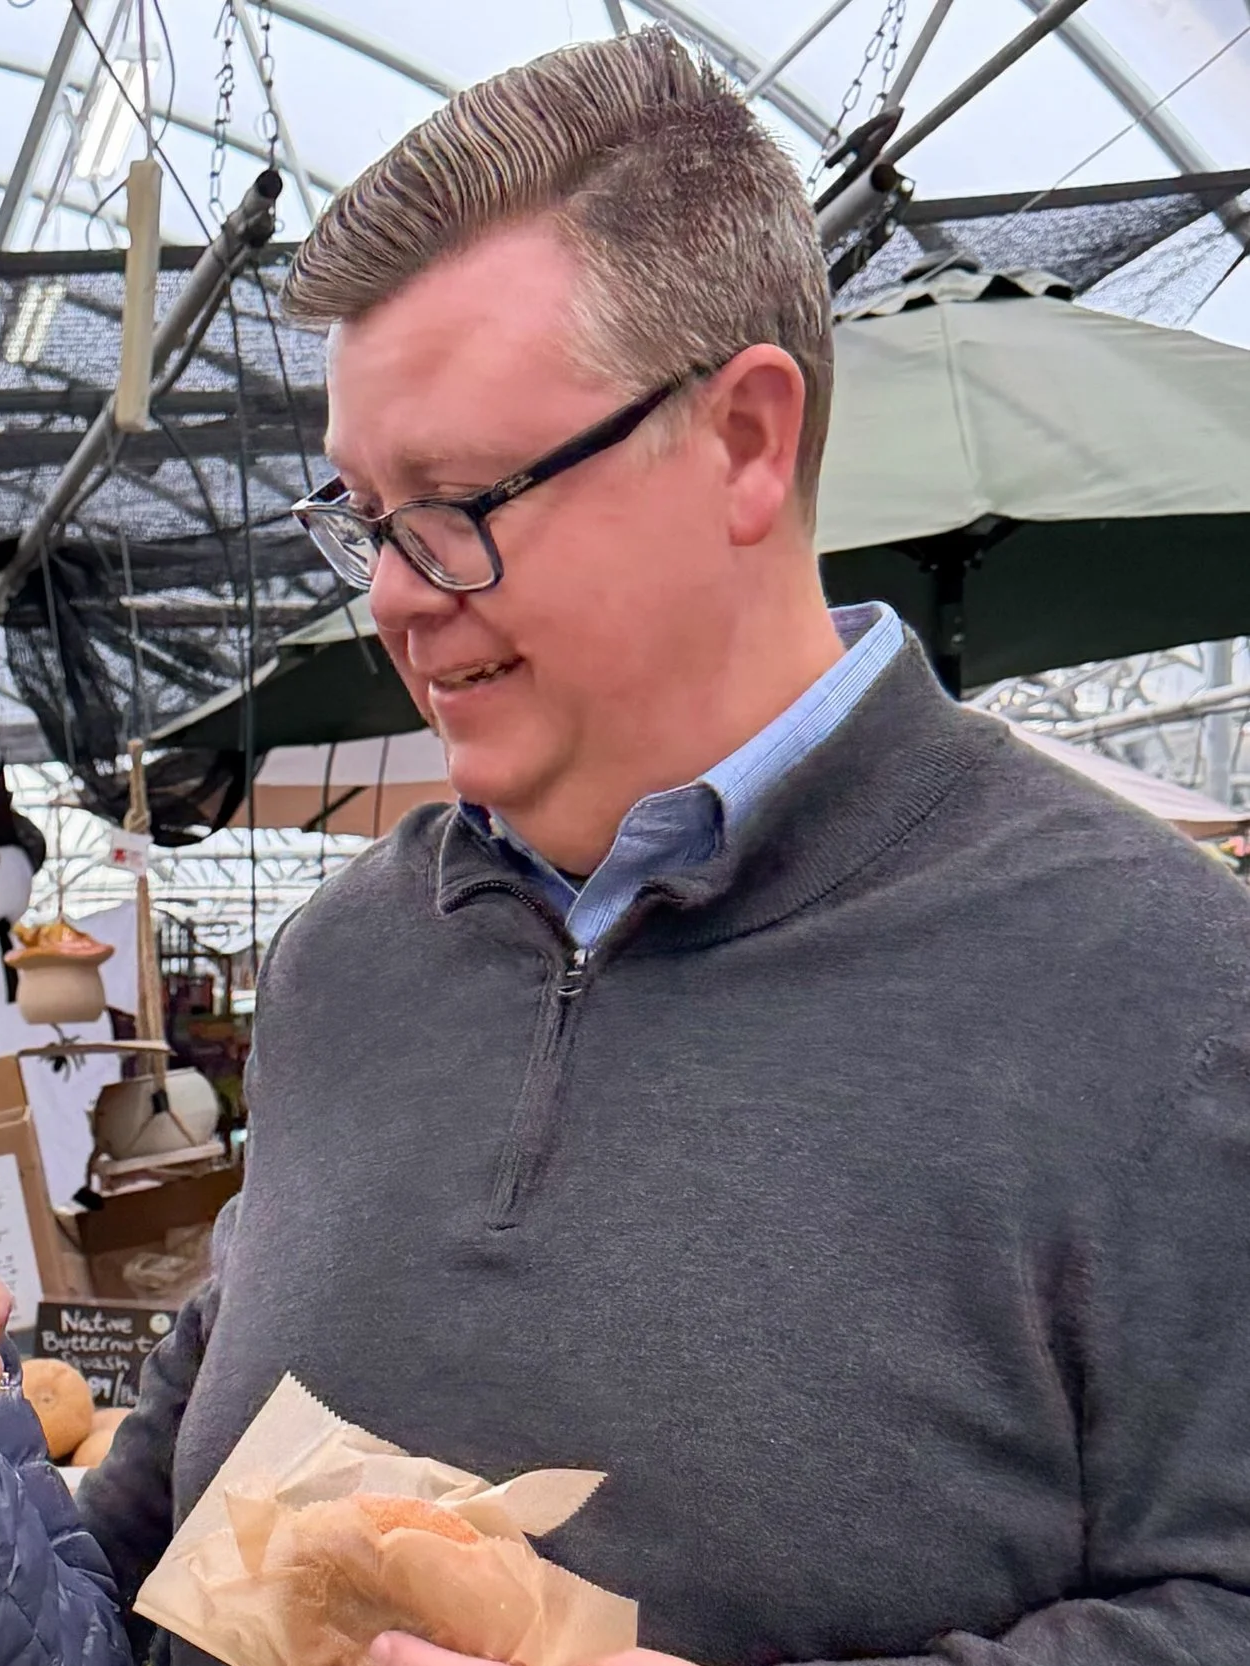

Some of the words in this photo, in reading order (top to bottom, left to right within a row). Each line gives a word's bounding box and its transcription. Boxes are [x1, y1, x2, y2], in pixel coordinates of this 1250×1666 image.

[60, 1309, 134, 1334] Native
[41, 1330, 154, 1353] Butternut
[60, 1351, 131, 1371] Squash
